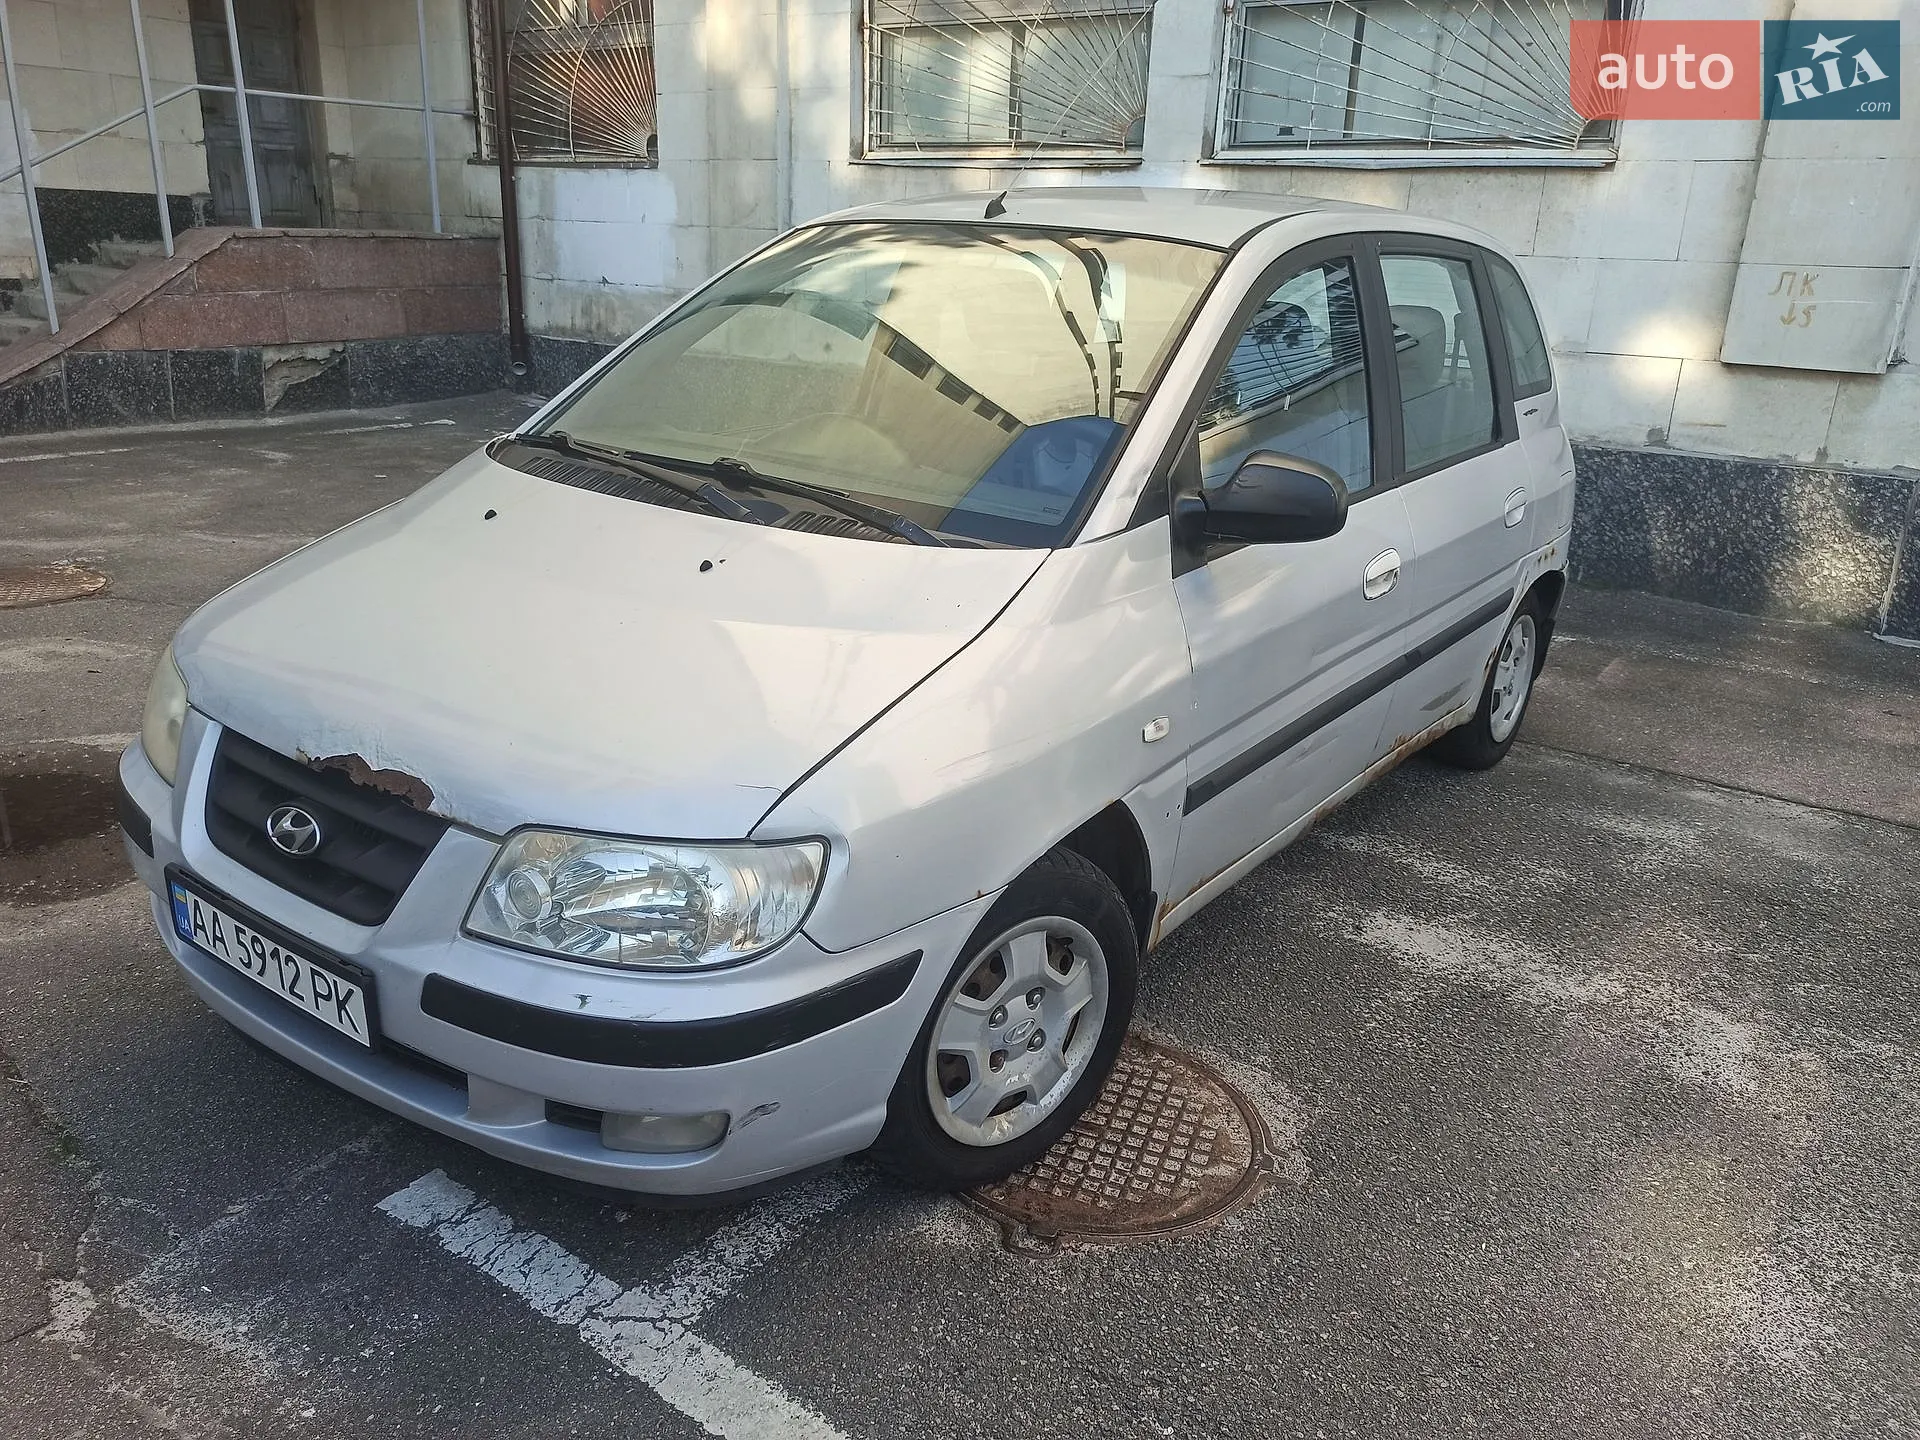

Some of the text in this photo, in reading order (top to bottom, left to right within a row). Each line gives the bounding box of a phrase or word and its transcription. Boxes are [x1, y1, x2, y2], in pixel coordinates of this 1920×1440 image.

[178, 914, 192, 933] UA
[193, 898, 361, 1035] AA 5912 PK
